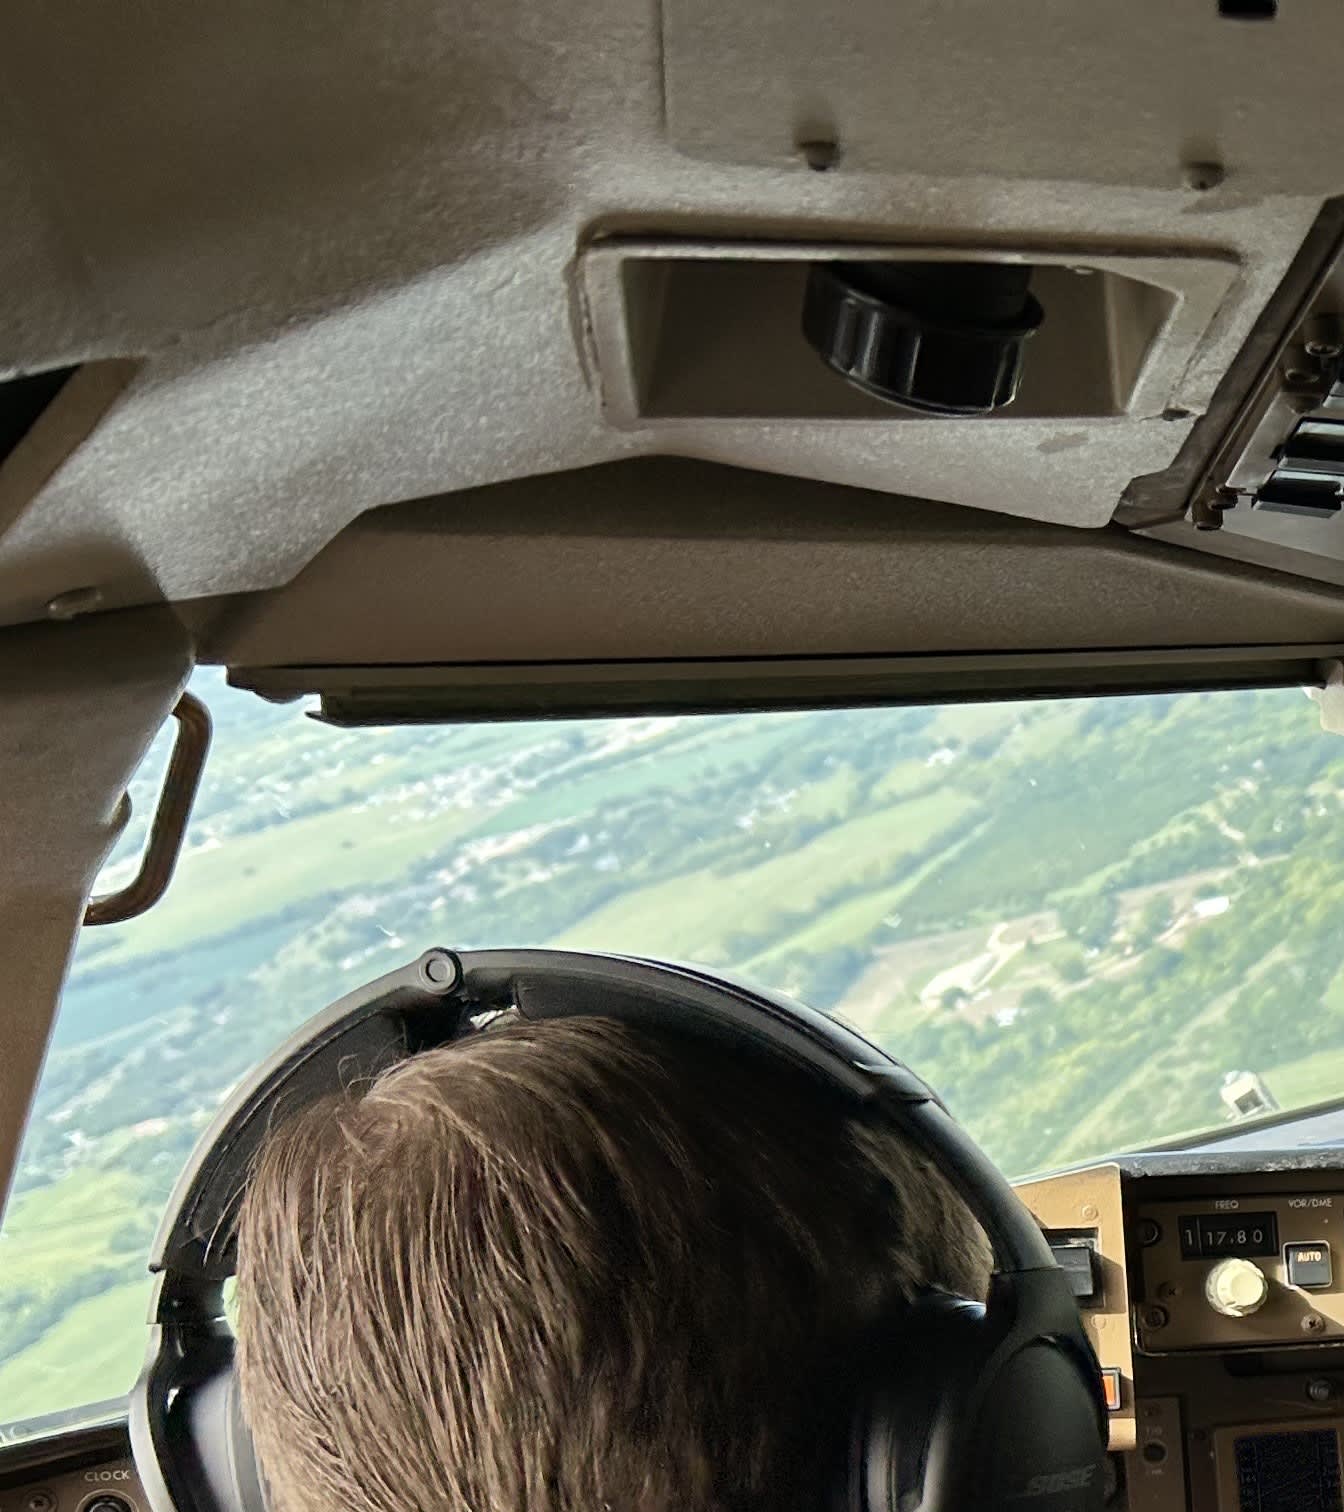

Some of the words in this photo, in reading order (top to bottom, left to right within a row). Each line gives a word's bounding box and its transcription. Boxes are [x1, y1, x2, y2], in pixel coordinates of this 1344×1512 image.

[1215, 1199, 1239, 1210] FREQ
[1288, 1198, 1333, 1209] VOR/DME
[1297, 1251, 1323, 1263] AUTO
[84, 1469, 130, 1482] CLOCK
